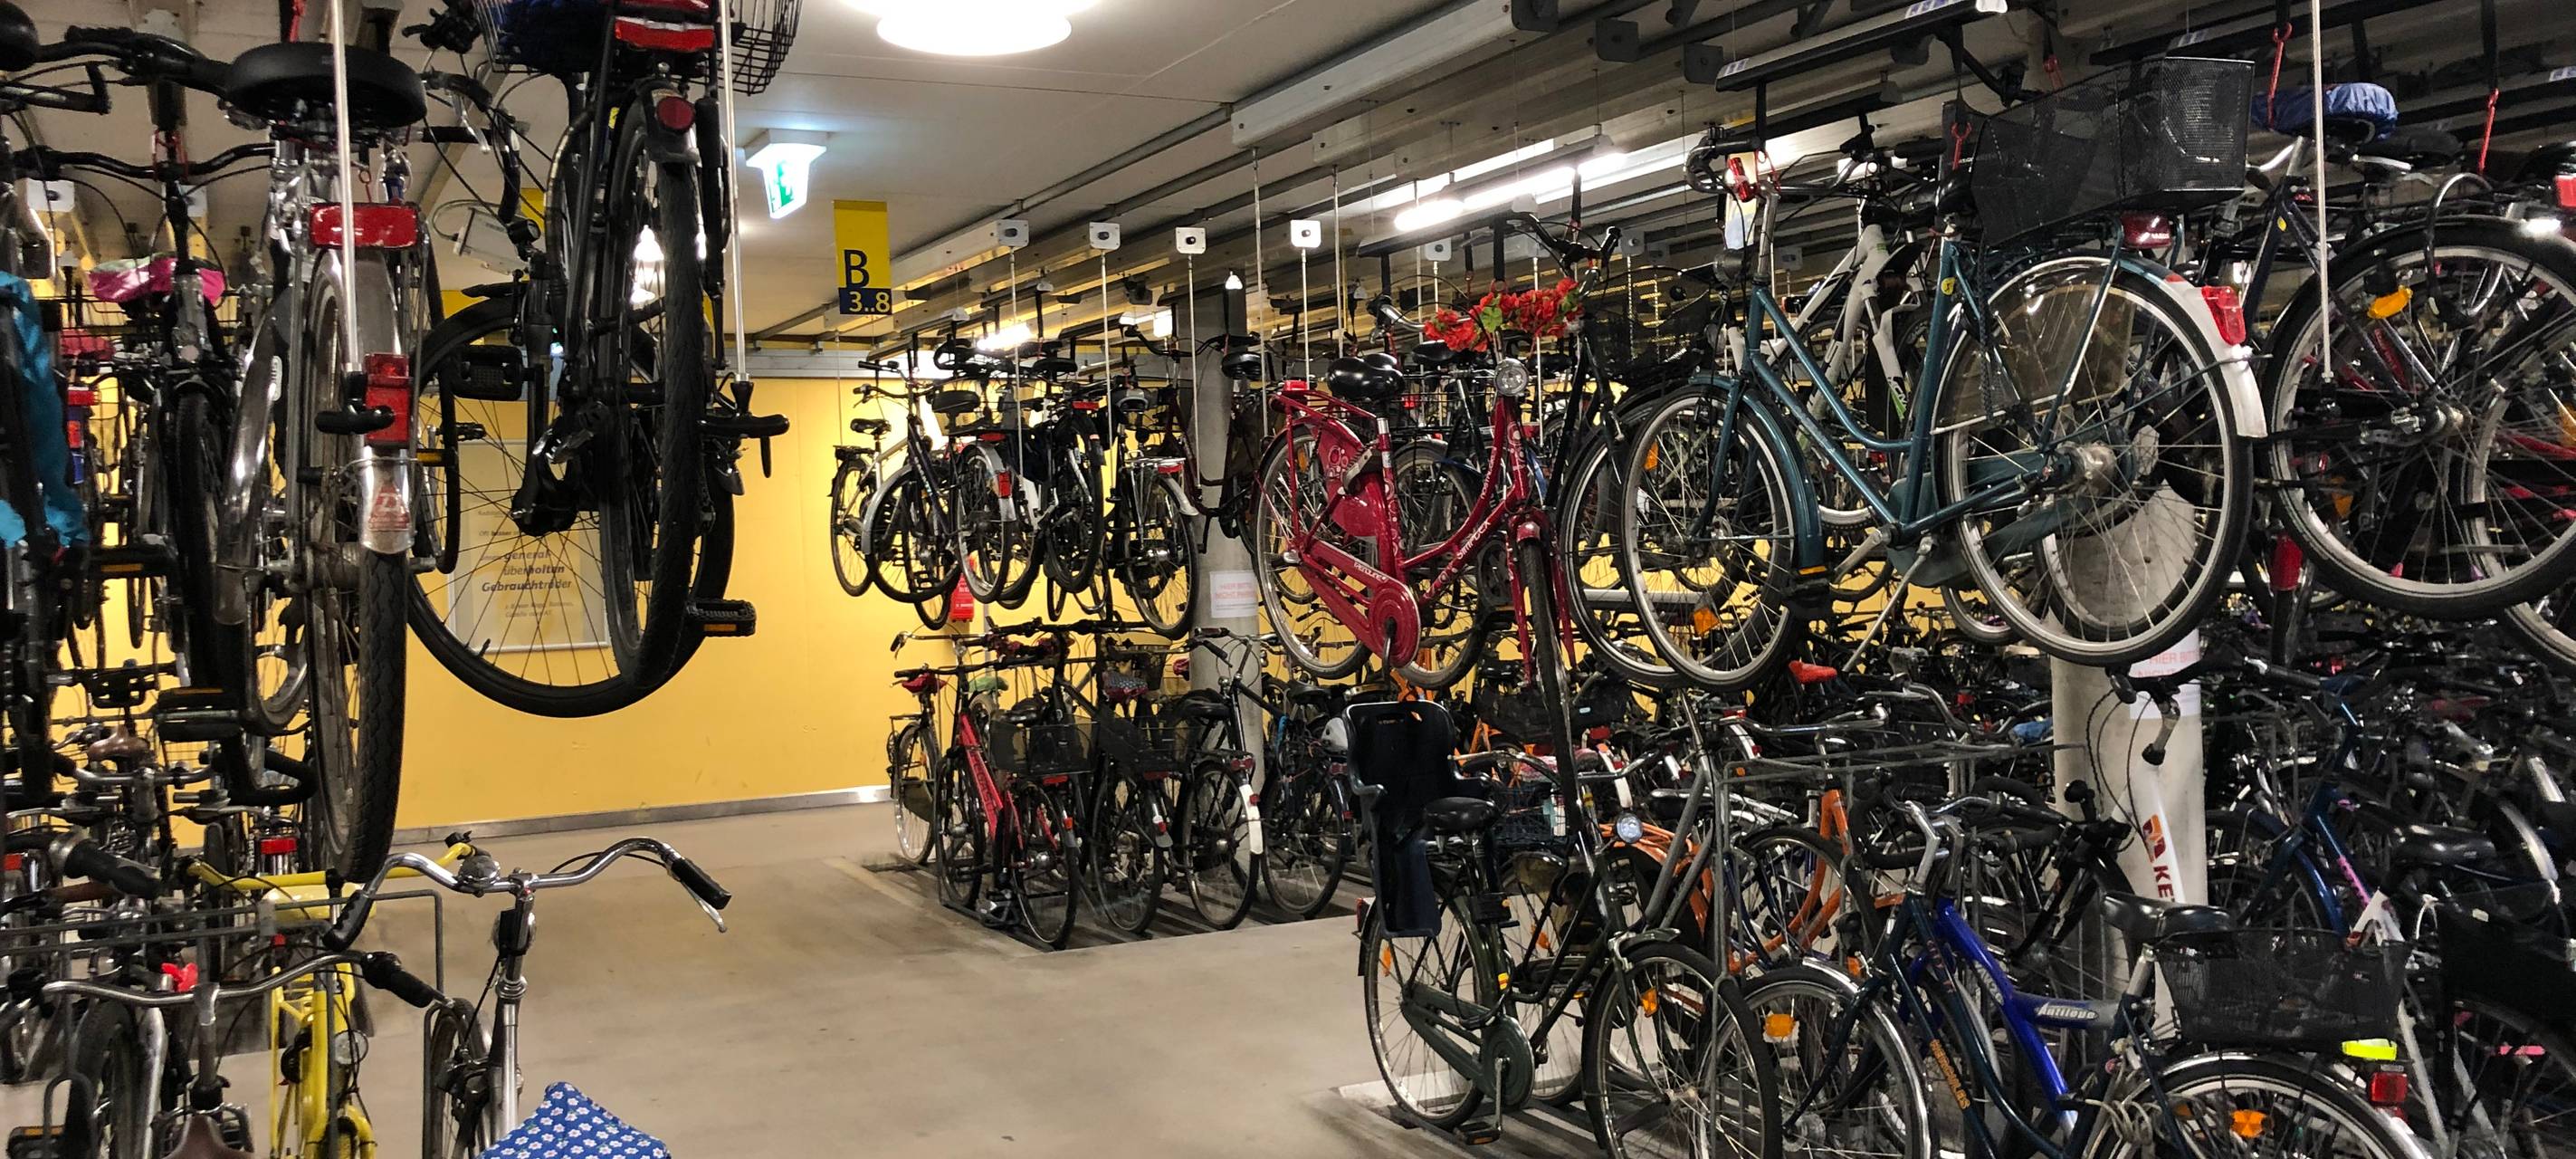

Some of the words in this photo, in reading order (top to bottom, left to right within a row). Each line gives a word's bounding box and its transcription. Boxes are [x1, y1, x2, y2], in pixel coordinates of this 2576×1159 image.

[844, 249, 870, 288] B
[849, 291, 891, 312] 3..8
[2152, 865, 2175, 903] KE
